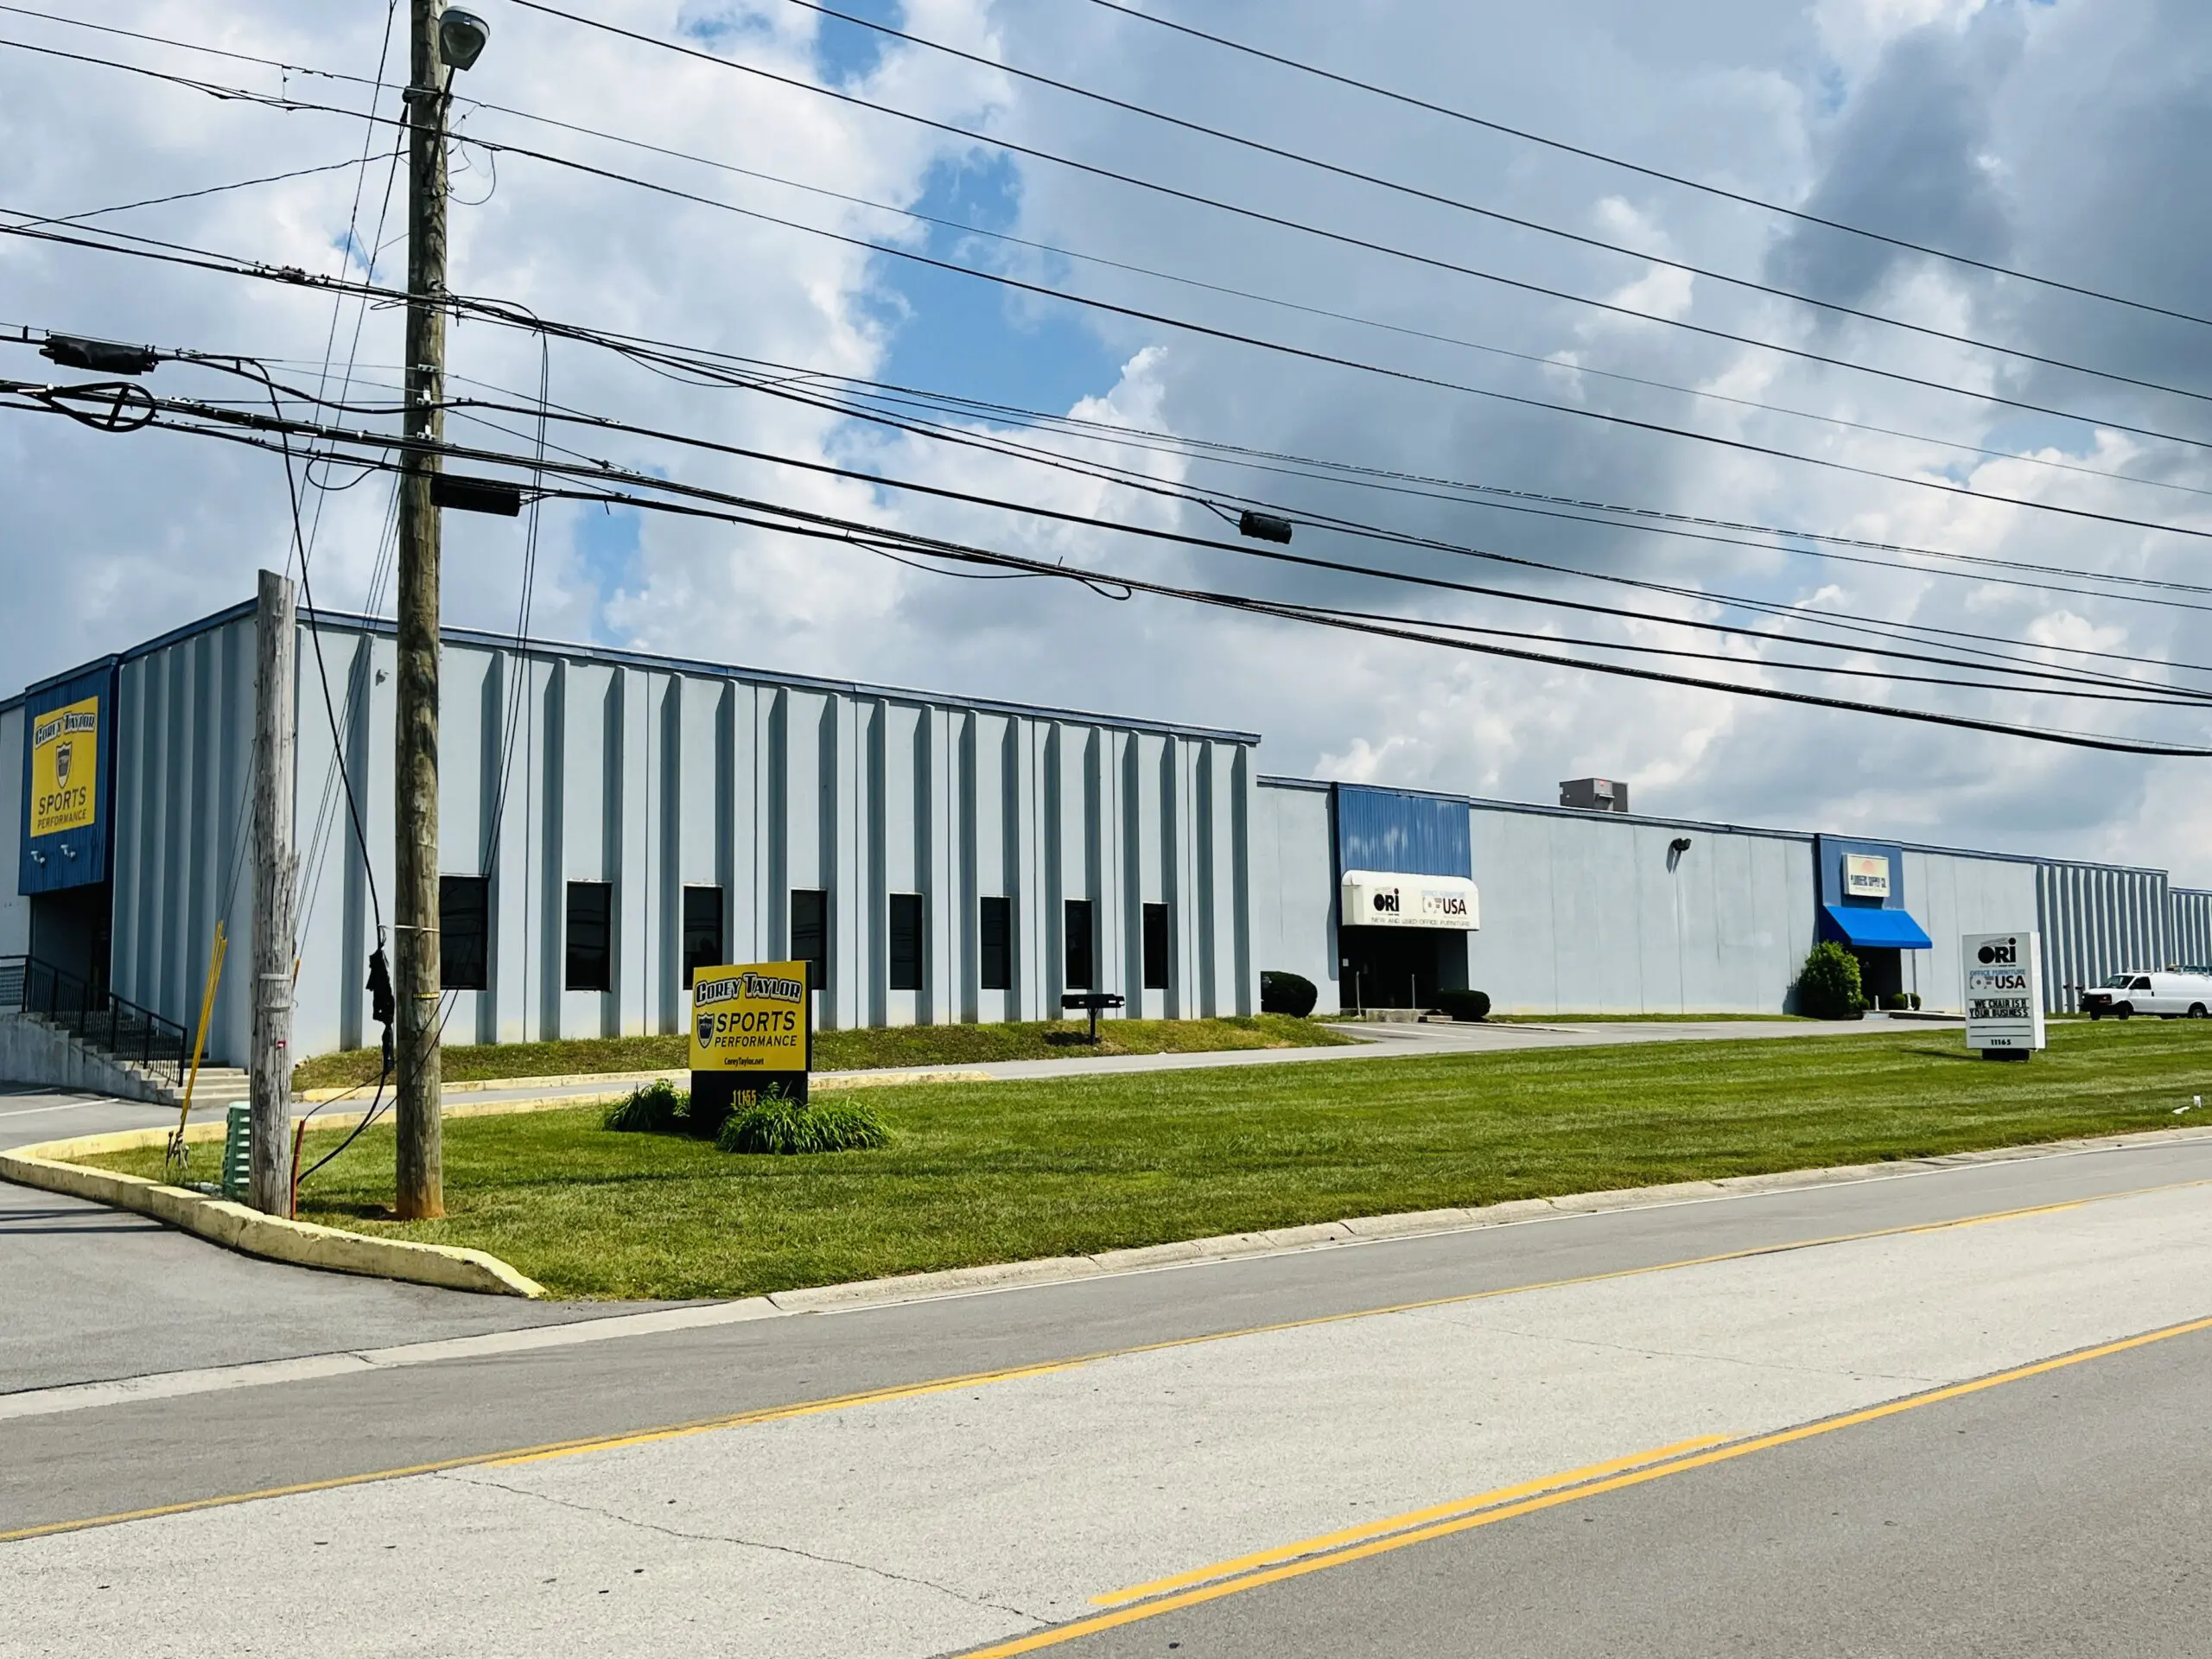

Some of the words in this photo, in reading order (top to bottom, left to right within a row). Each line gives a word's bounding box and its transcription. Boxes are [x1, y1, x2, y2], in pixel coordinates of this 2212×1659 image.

[38, 786, 86, 816] SPORTS
[37, 809, 86, 830] PERFORMANCE
[1443, 898, 1467, 915] USA
[695, 977, 742, 1007] COREY
[742, 972, 803, 1003] TAYLOR
[1995, 976, 2026, 989] USA
[1974, 999, 1986, 1008] WE
[1969, 1008, 1990, 1017] YOUR
[716, 1011, 796, 1033] SPORTS
[715, 1035, 798, 1047] PERFORMANCE
[724, 1057, 764, 1067] CoreyTaylor.net
